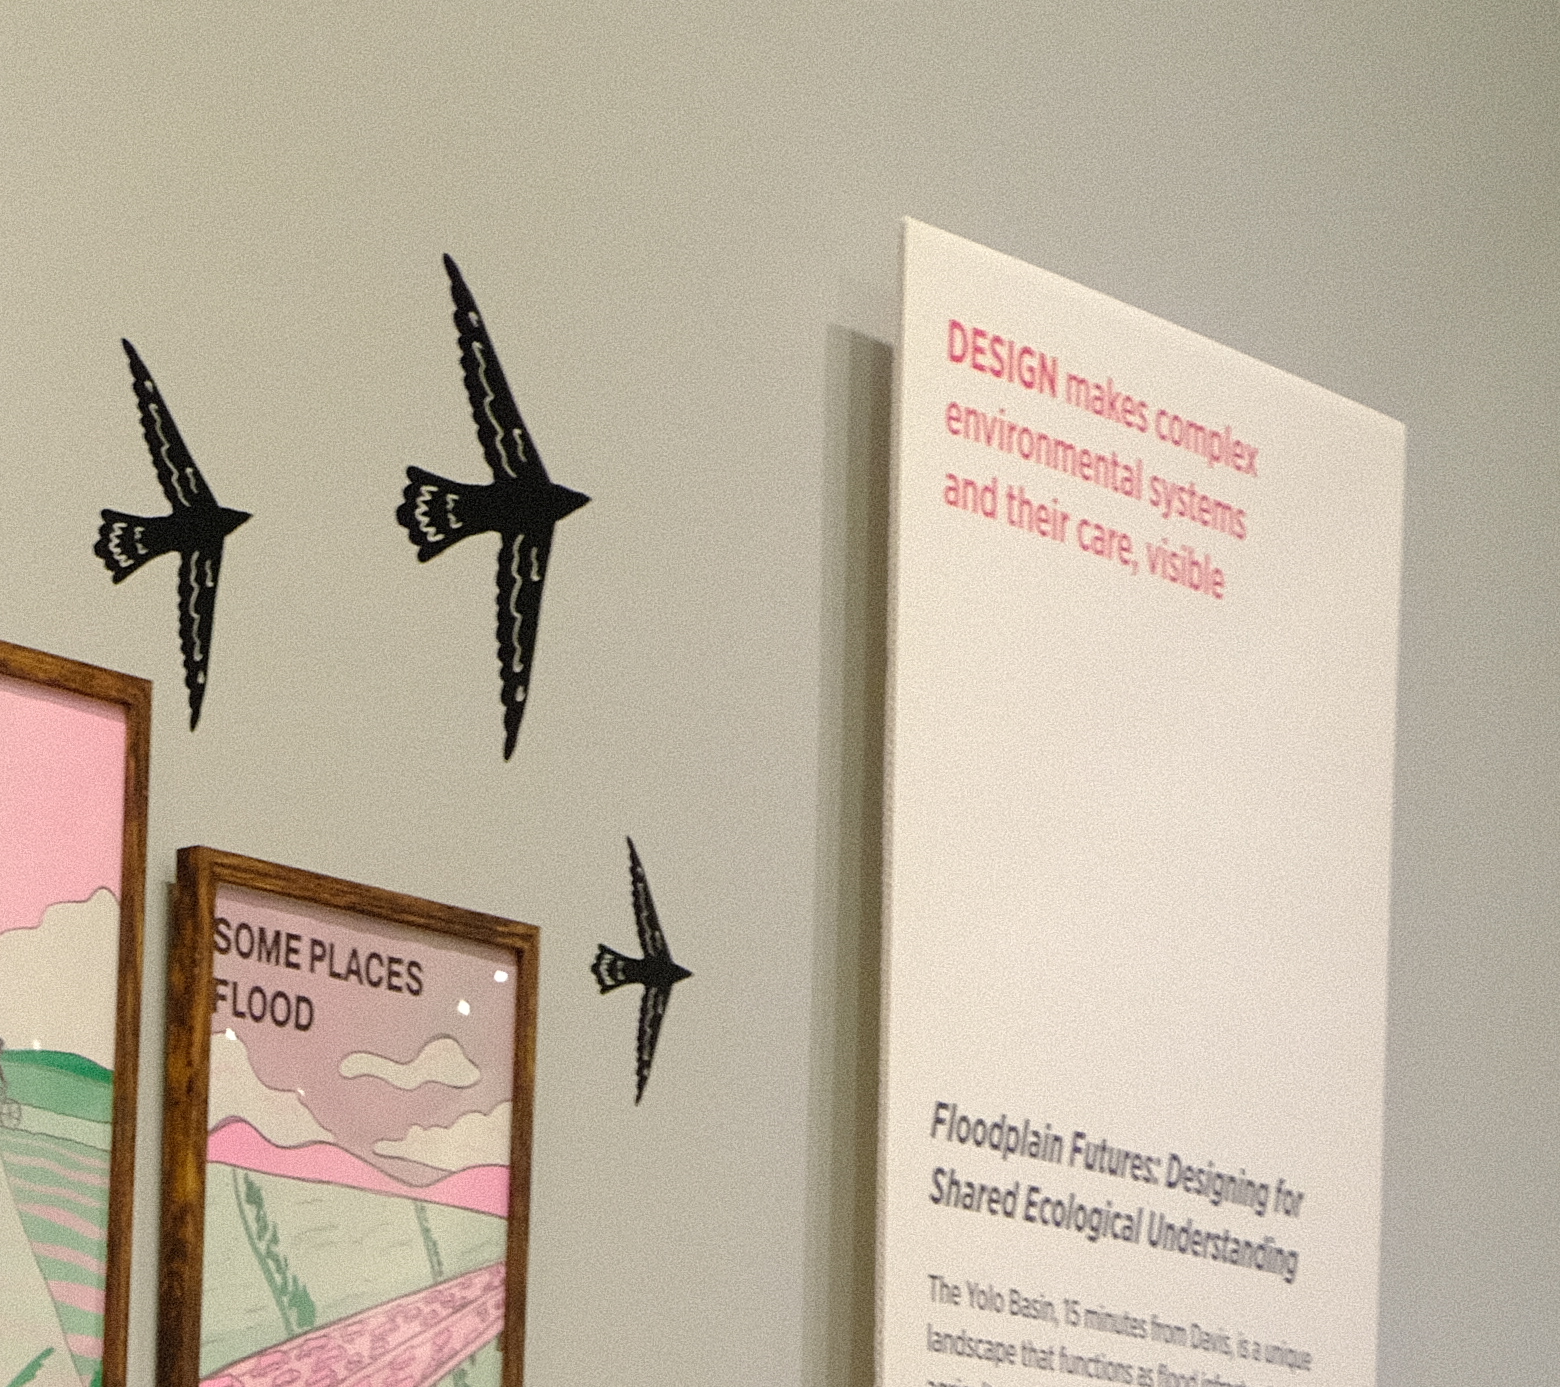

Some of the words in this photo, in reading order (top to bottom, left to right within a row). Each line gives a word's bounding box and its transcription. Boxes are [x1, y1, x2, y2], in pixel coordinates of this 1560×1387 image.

[947, 319, 1058, 399] DESIGN
[1066, 372, 1148, 433] makes
[1154, 408, 1259, 477] complex
[945, 401, 1143, 501] environmental
[1149, 473, 1247, 540] systems
[944, 472, 998, 520] and
[1005, 484, 1070, 543] their
[1077, 516, 1139, 577] care,
[1145, 536, 1226, 600] visible
[213, 917, 302, 970] SOME
[308, 936, 424, 996] PLACES
[213, 977, 315, 1032] FLOOD
[930, 1101, 1063, 1164] Floodplain
[1069, 1131, 1164, 1187] Futures:
[1165, 1152, 1271, 1219] Designing
[1273, 1177, 1305, 1220] for
[929, 1166, 1020, 1220] Shared
[1023, 1185, 1143, 1243] Ecological
[1147, 1207, 1301, 1285] Understanding
[928, 1273, 962, 1307] The
[966, 1280, 1006, 1314] Yolo
[1009, 1287, 1060, 1328] Basin,
[1063, 1298, 1081, 1327] 15
